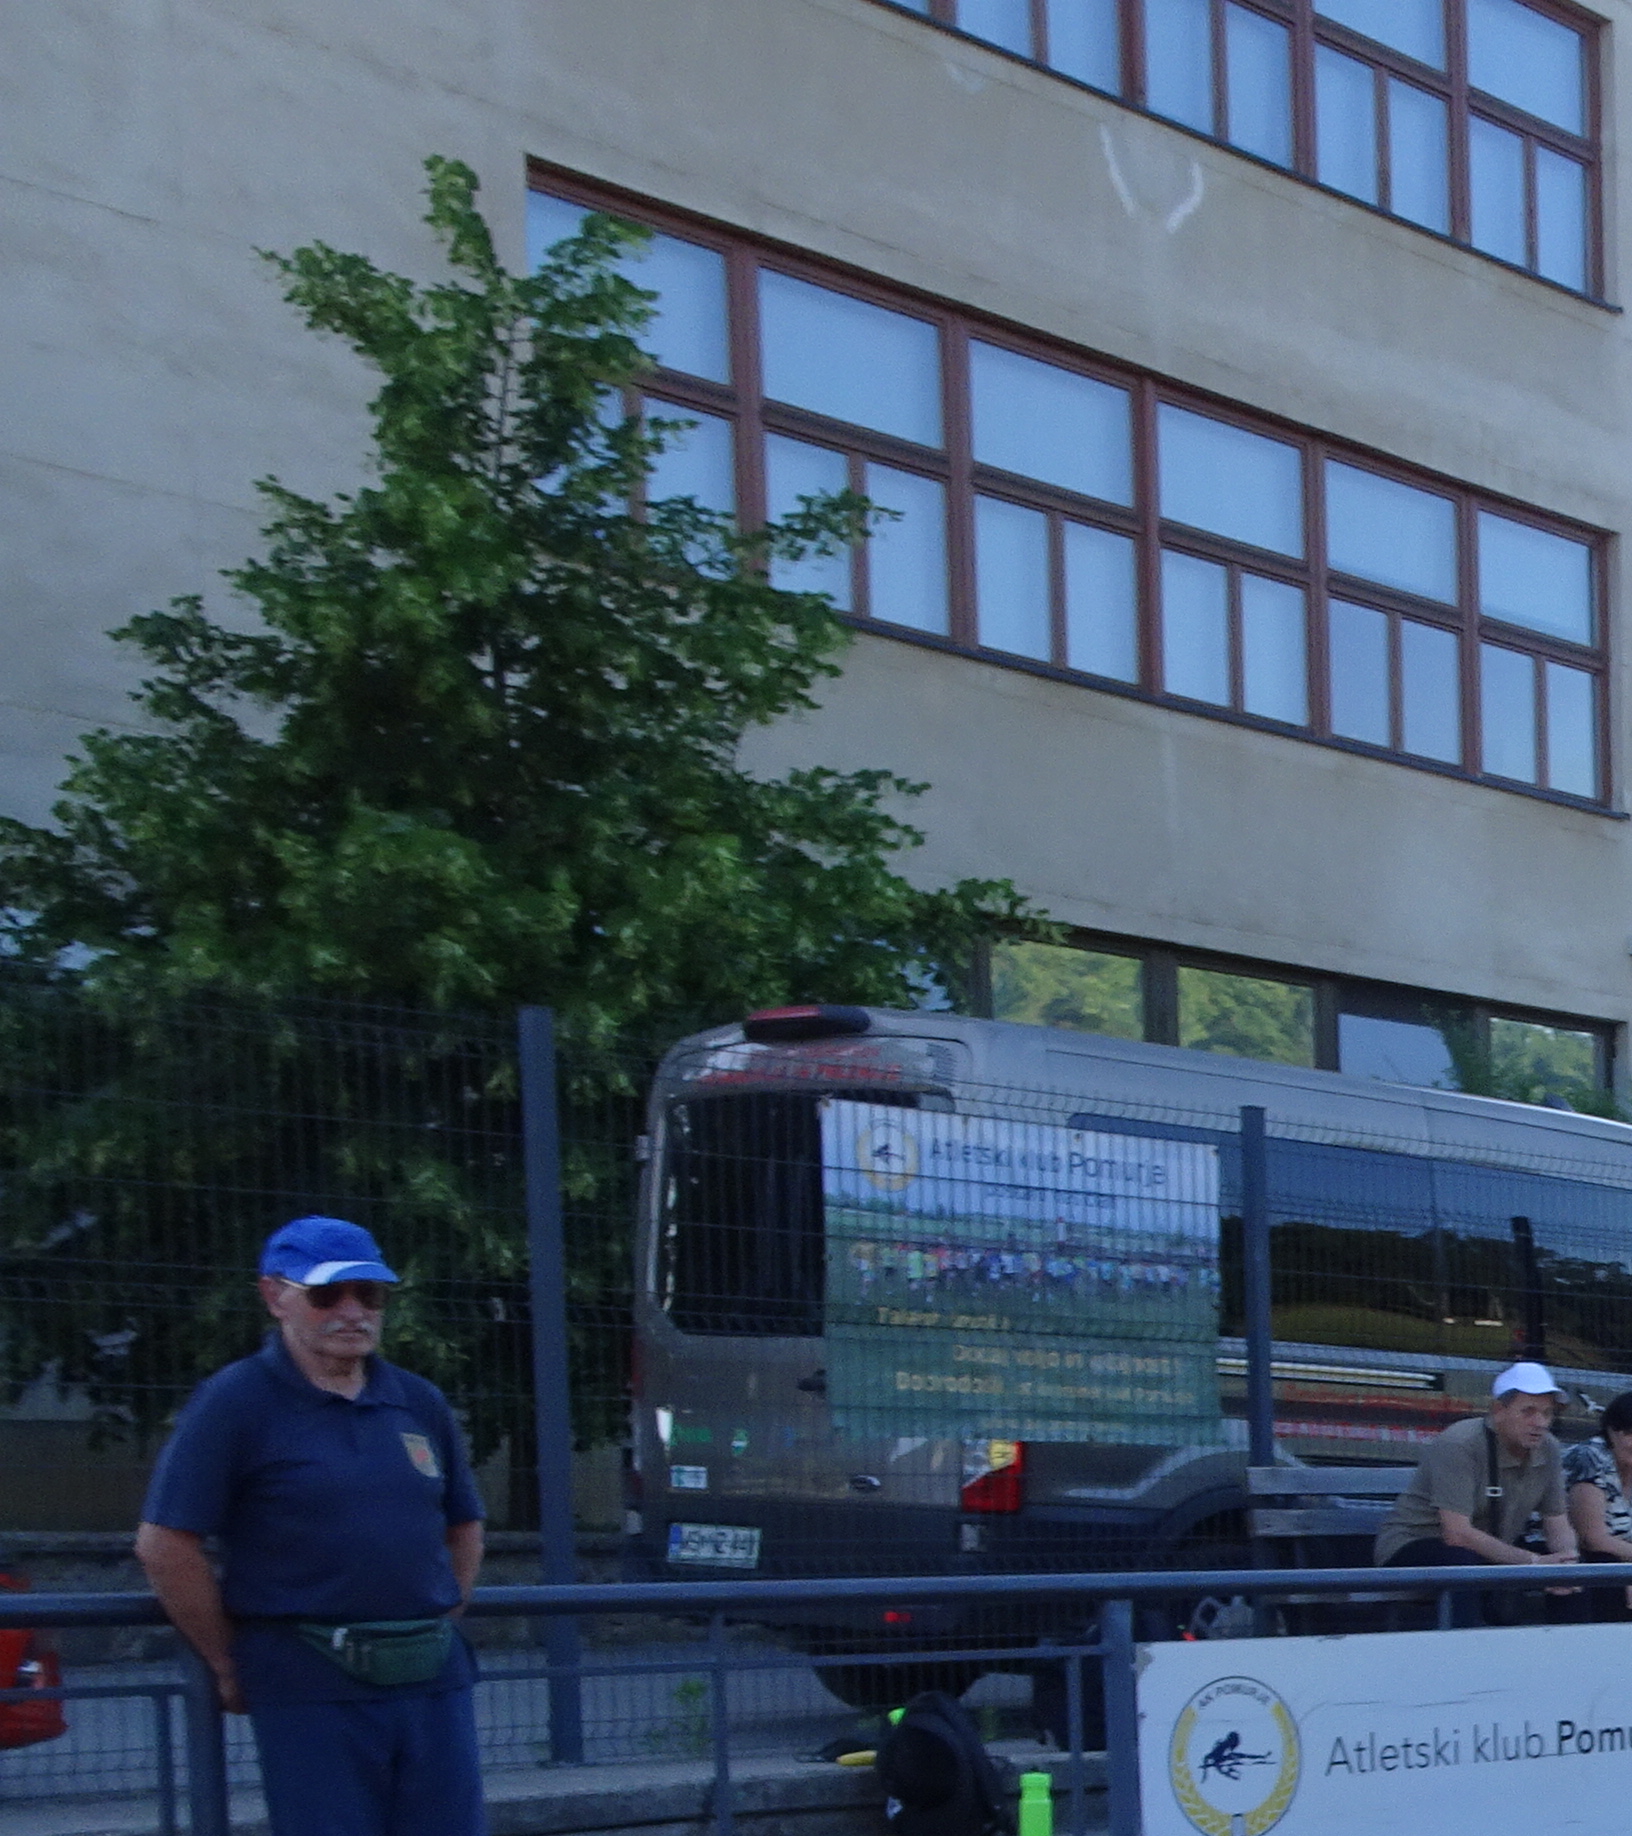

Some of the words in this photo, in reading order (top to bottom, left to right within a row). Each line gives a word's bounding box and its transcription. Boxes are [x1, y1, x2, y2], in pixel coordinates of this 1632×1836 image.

[1068, 1151, 1167, 1185] Pomurje
[1324, 1726, 1460, 1777] Atletski
[1473, 1719, 1544, 1764] klub
